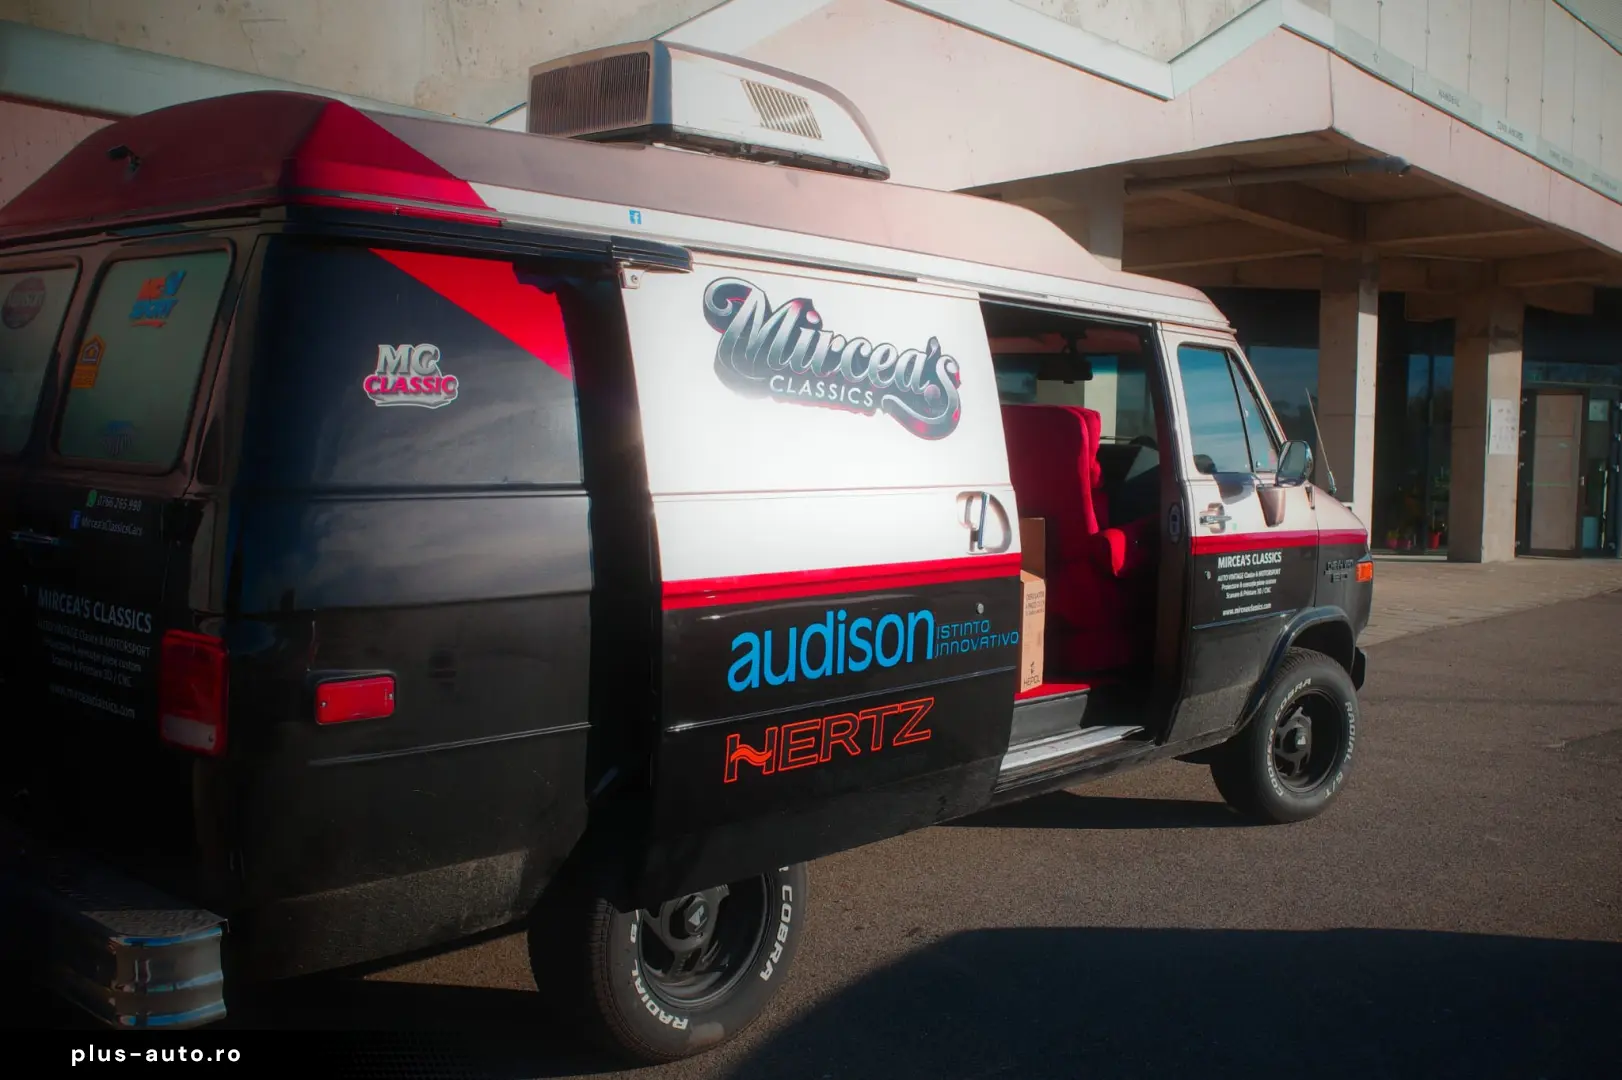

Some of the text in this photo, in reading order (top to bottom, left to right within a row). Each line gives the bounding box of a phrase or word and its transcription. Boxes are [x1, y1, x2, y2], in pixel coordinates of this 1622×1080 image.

[364, 376, 457, 394] CLASSIC
[703, 278, 960, 430] Mircea's
[769, 375, 874, 408] CLASSICS
[1217, 551, 1282, 569] MIRCEA'S CLASSICS
[38, 586, 152, 634] MIRCEA'S CLASSICS
[727, 609, 935, 693] audison
[723, 696, 935, 785] HERTZ
[1274, 677, 1312, 722] COBRA
[1344, 701, 1355, 764] RADIAL
[760, 884, 793, 982] COBRA
[631, 958, 689, 1031] RADIAL
